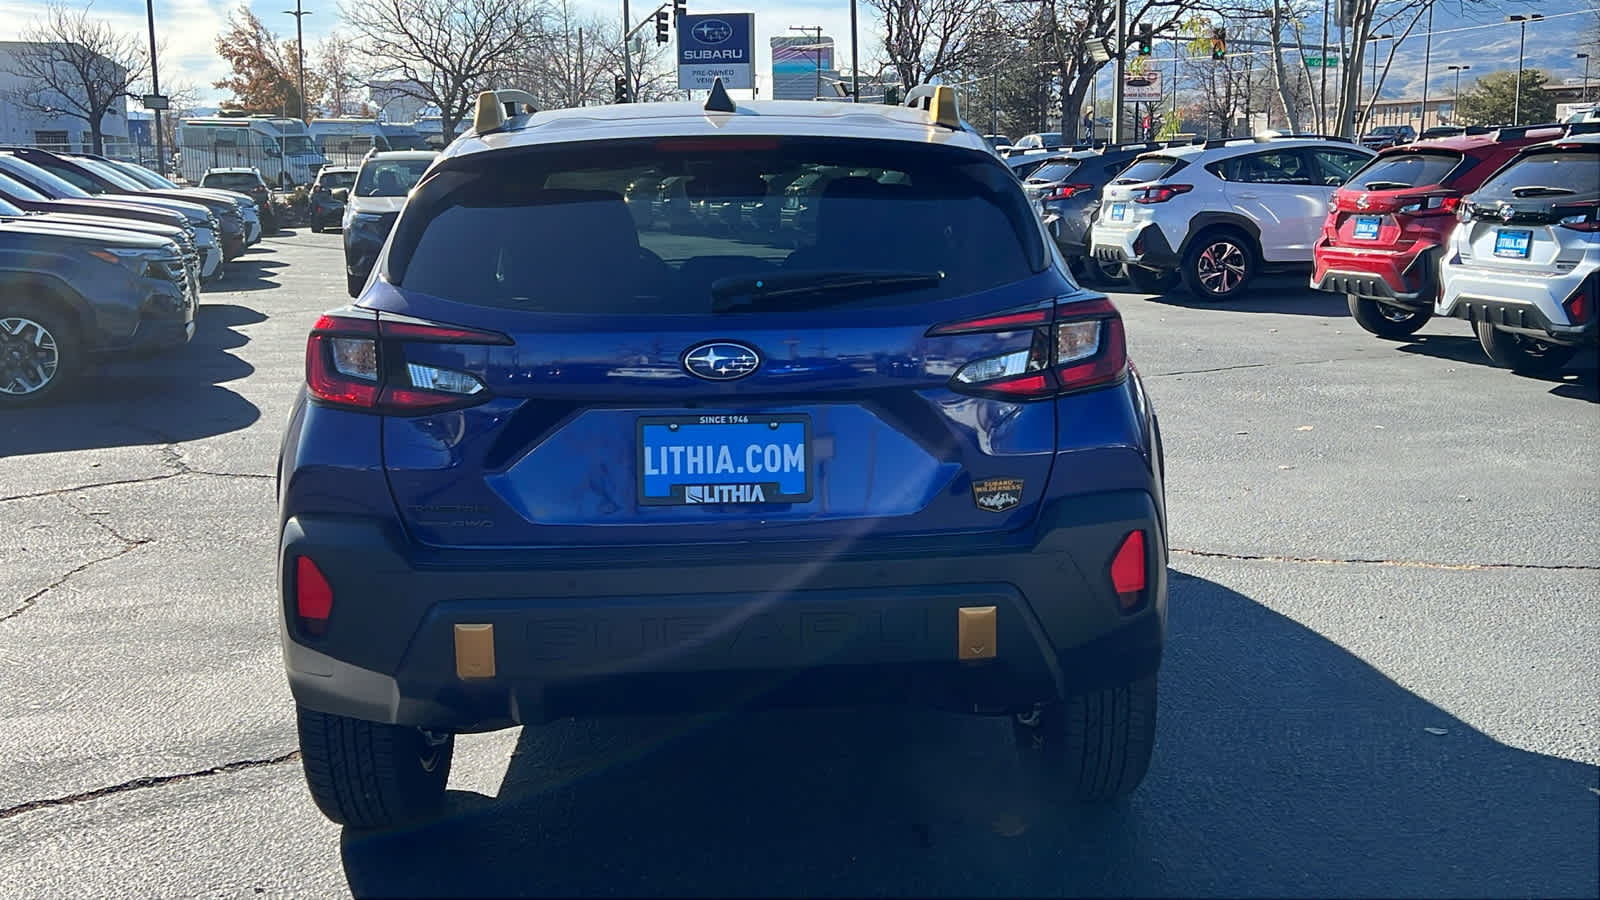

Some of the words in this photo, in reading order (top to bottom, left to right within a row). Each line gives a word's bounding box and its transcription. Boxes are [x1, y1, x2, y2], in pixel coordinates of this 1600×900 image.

[684, 49, 743, 59] SUBARU
[699, 415, 727, 424] SINCE
[728, 415, 749, 424] 1946
[644, 443, 805, 475] LITHIA.COM
[703, 484, 766, 503] LITHIA
